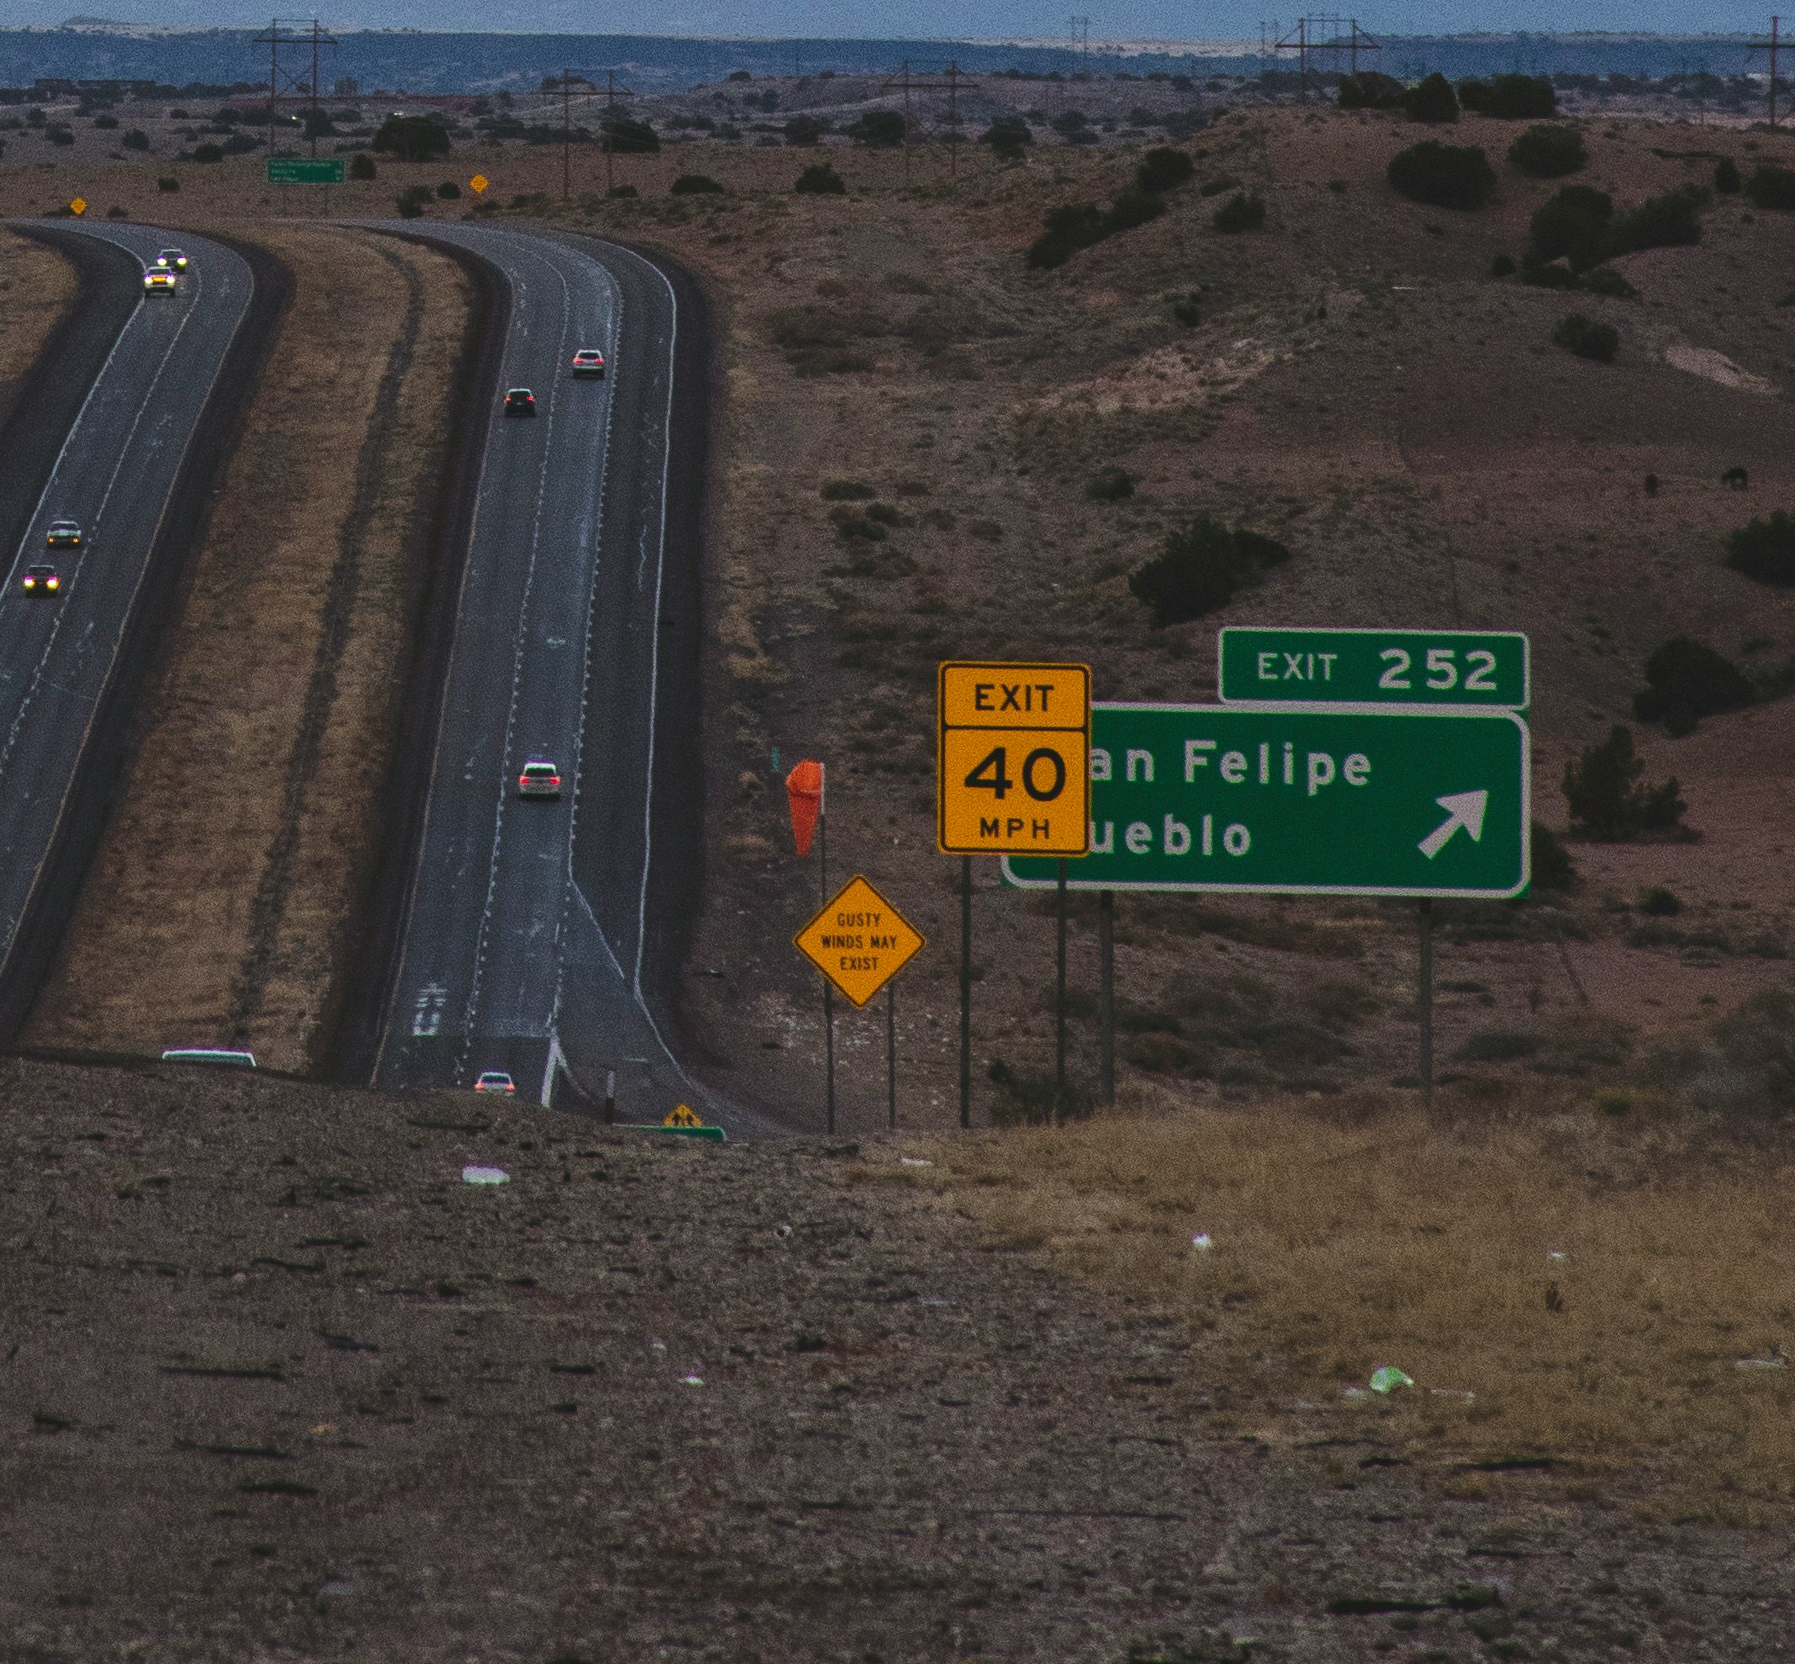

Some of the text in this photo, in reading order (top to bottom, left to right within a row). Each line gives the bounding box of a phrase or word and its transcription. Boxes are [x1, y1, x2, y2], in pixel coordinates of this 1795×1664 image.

[1257, 648, 1498, 691] EXIT 252
[974, 683, 1054, 712] EXIT
[964, 746, 1067, 802] 40
[1090, 739, 1372, 796] an Felipe
[979, 817, 1050, 839] MPH
[1090, 813, 1252, 857] ueblo
[837, 913, 882, 927] GUSTY
[821, 935, 897, 950] WINDS MAY
[839, 957, 879, 971] EXIST
